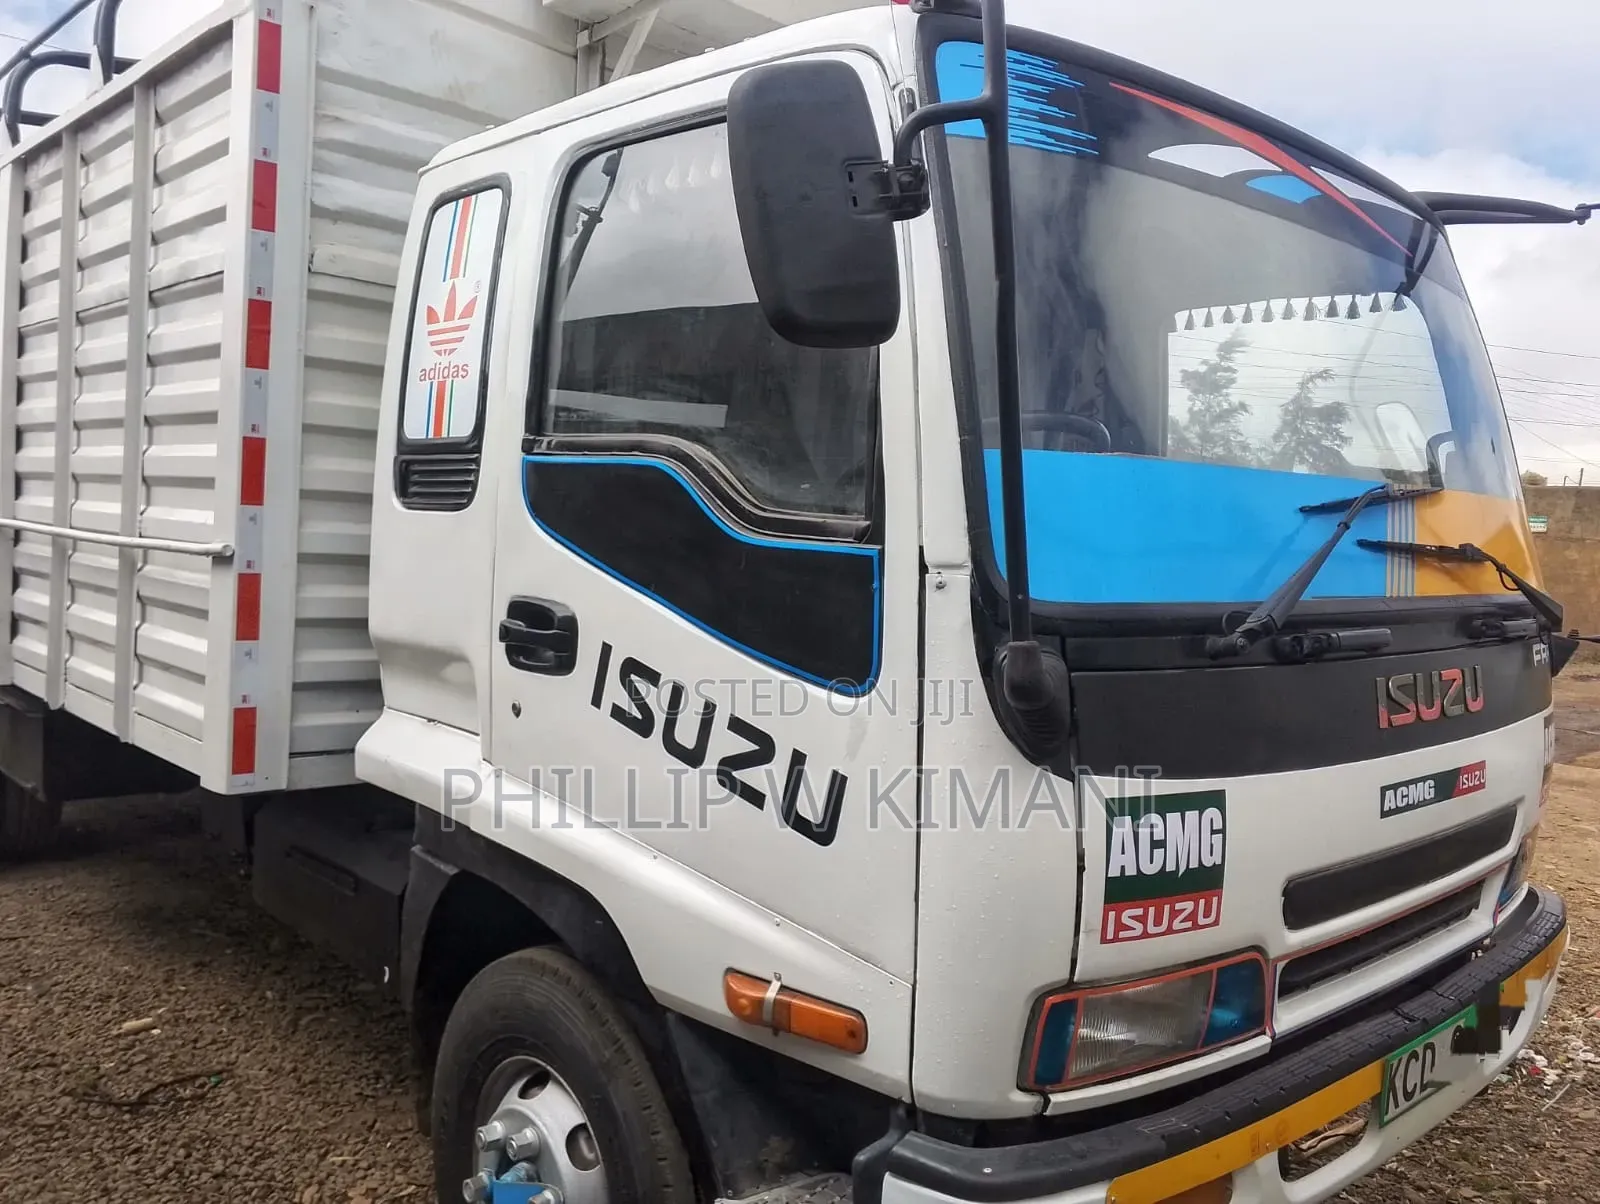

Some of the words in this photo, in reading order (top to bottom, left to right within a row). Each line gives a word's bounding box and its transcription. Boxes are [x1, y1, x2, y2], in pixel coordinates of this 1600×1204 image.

[419, 361, 469, 383] adidas
[1376, 664, 1485, 729] ISUZU
[590, 640, 849, 848] ISUZU
[1383, 779, 1436, 812] ACMG
[1459, 769, 1486, 790] ISUZU
[1107, 806, 1224, 878] ACMG
[1106, 896, 1220, 940] ISUZU
